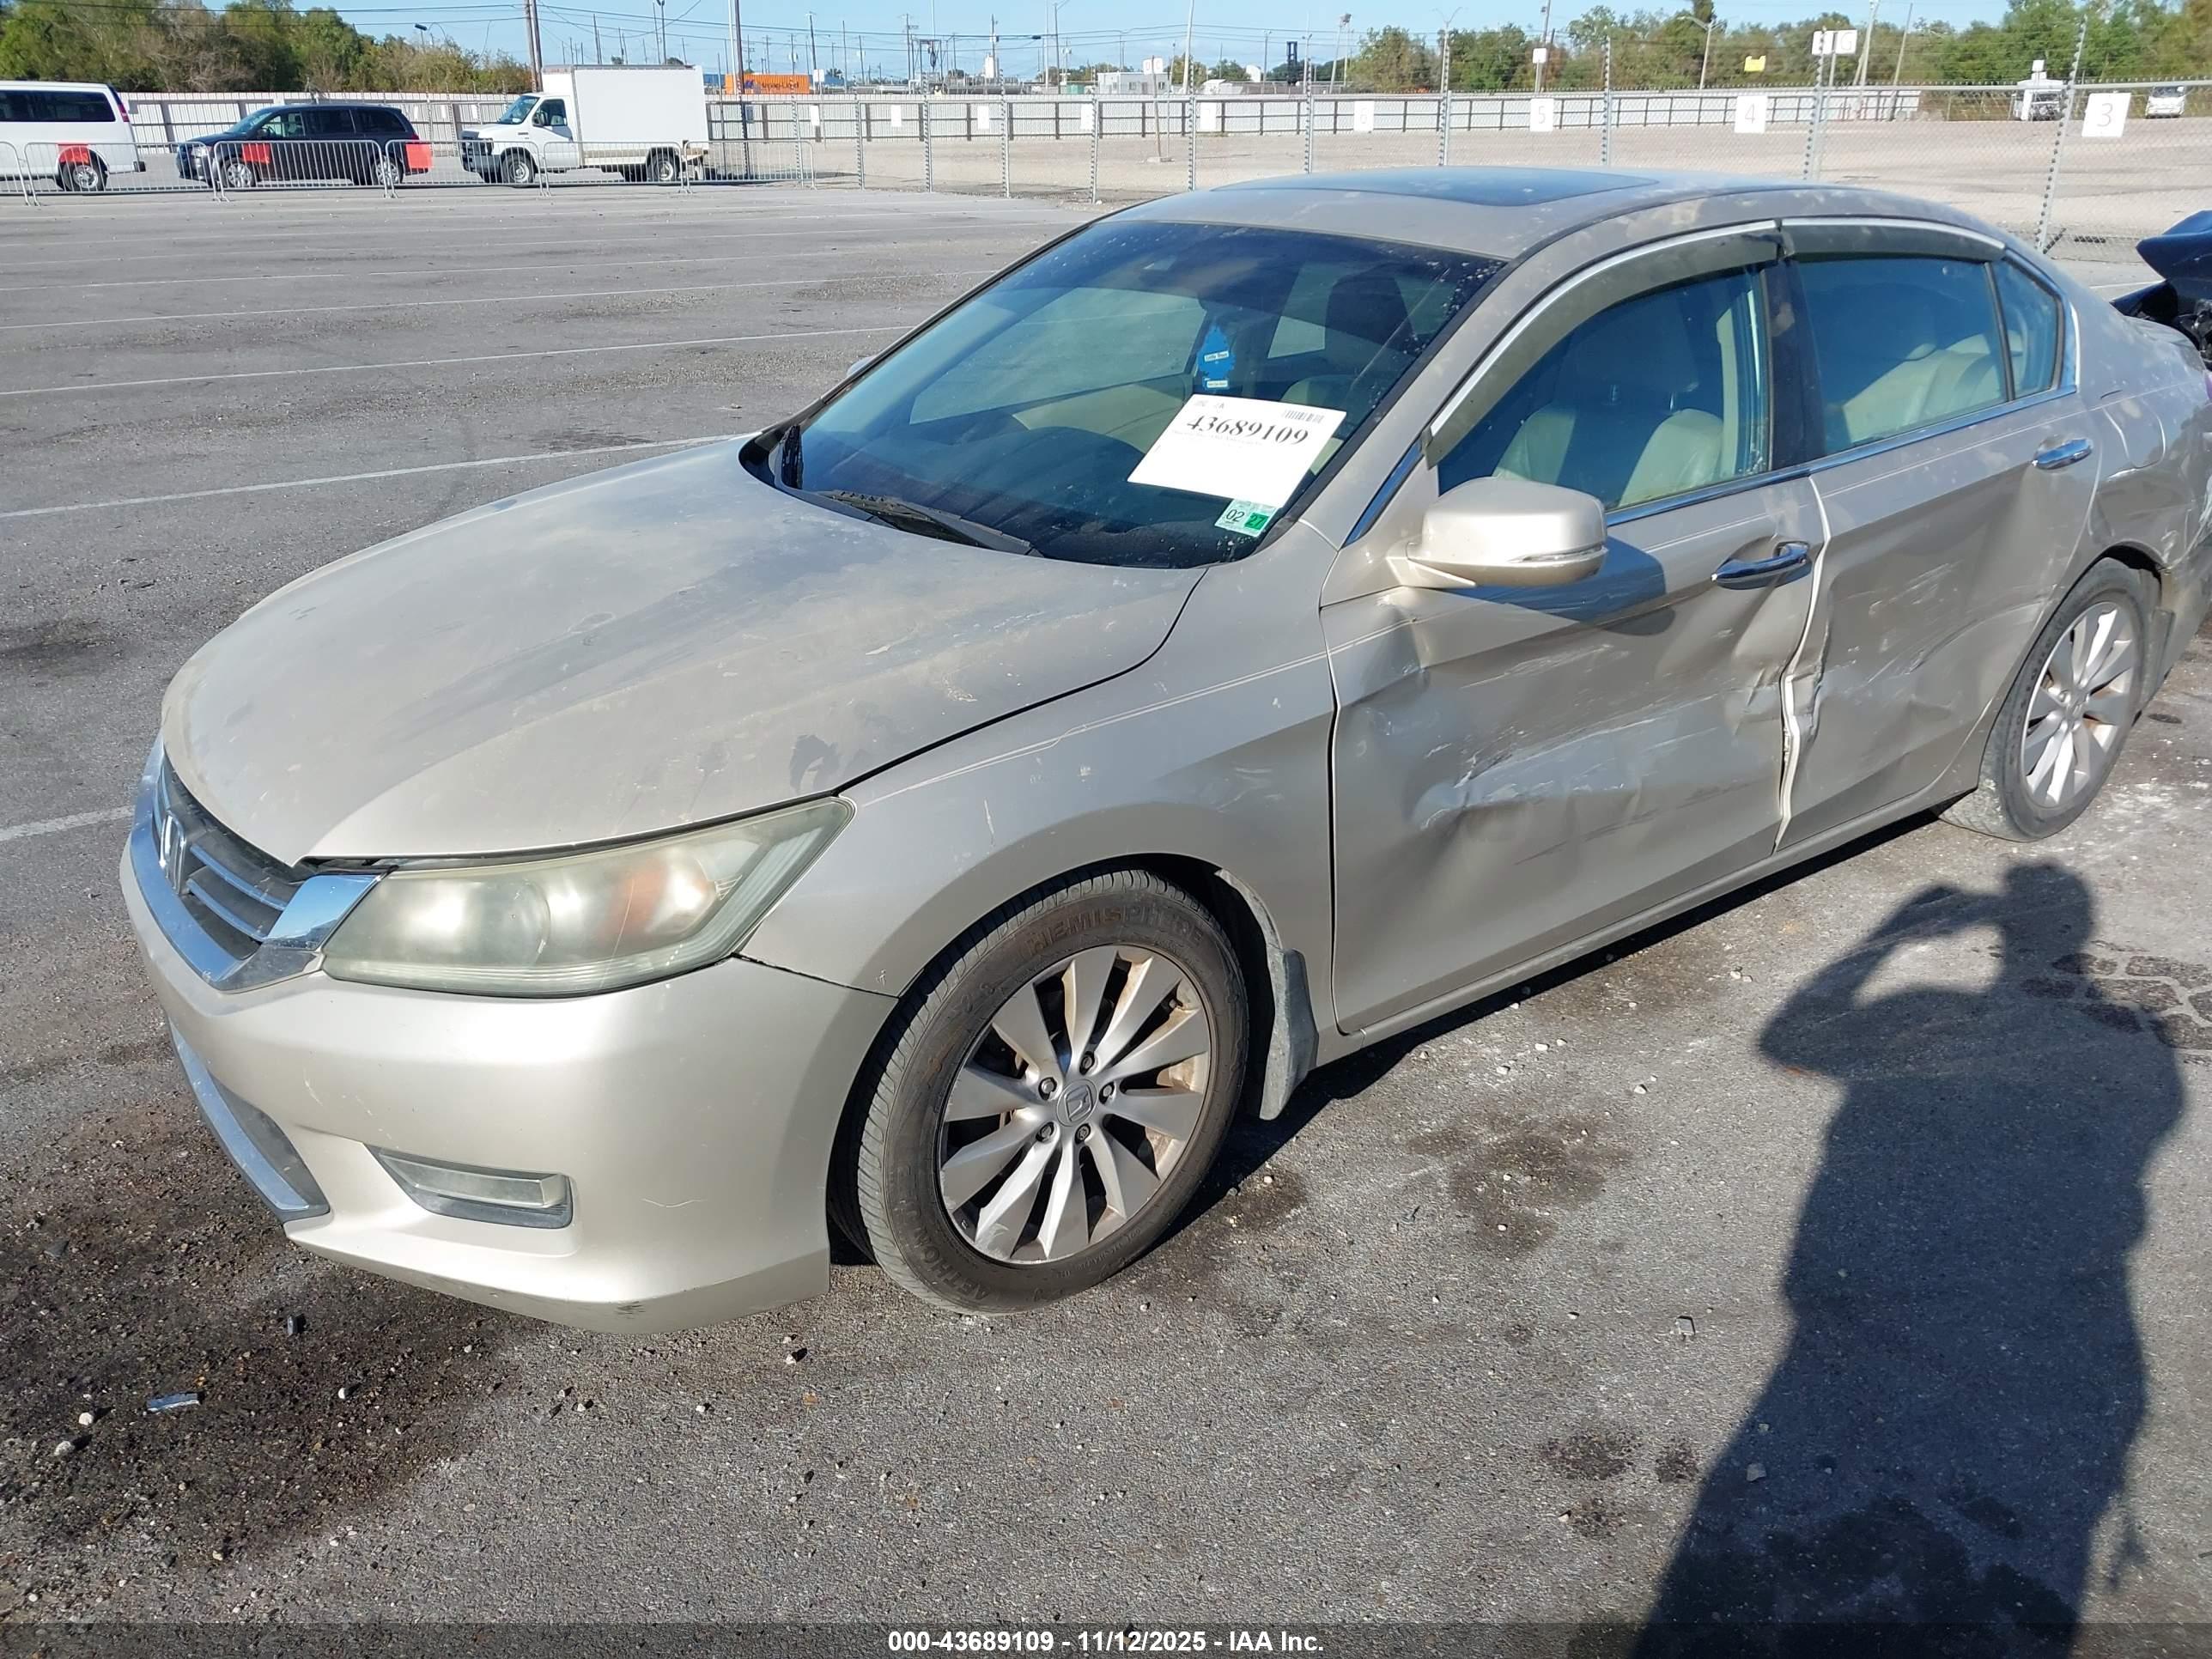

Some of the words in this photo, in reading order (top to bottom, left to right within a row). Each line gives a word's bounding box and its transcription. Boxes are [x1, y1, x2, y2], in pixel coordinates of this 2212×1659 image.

[1538, 105, 1546, 125] 5
[1744, 102, 1756, 125] 4
[2096, 102, 2114, 128] 3
[1187, 416, 1309, 445] 43689109
[1225, 508, 1245, 522] 02
[1244, 514, 1266, 527] 27
